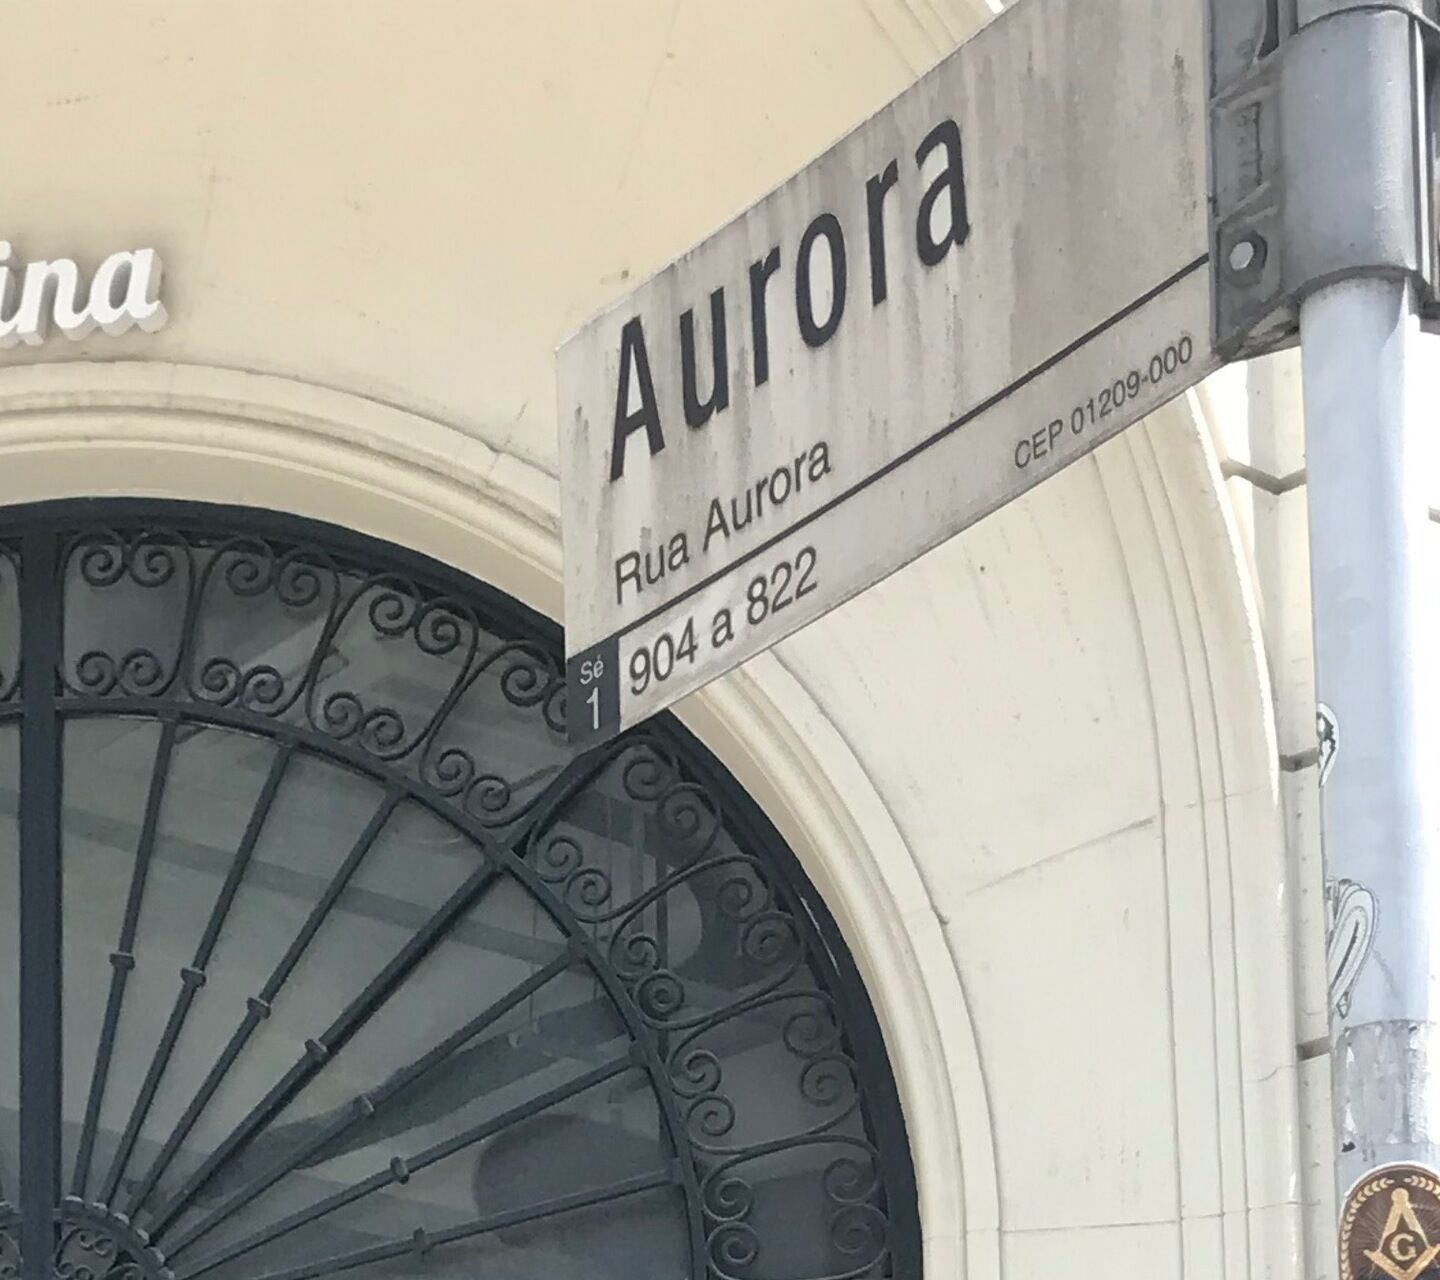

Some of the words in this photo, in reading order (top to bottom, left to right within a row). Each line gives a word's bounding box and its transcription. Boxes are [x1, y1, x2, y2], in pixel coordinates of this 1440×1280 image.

[609, 118, 971, 483] Aurora
[1013, 418, 1065, 470] CEP
[1070, 337, 1194, 436] 01209-000
[615, 532, 689, 604] Rua
[702, 440, 832, 553] Aurora
[579, 655, 604, 686] Sé
[629, 616, 697, 695] 904
[711, 608, 735, 649] a
[746, 547, 819, 625] 822
[587, 687, 602, 730] 1
[1389, 1233, 1417, 1262] G
